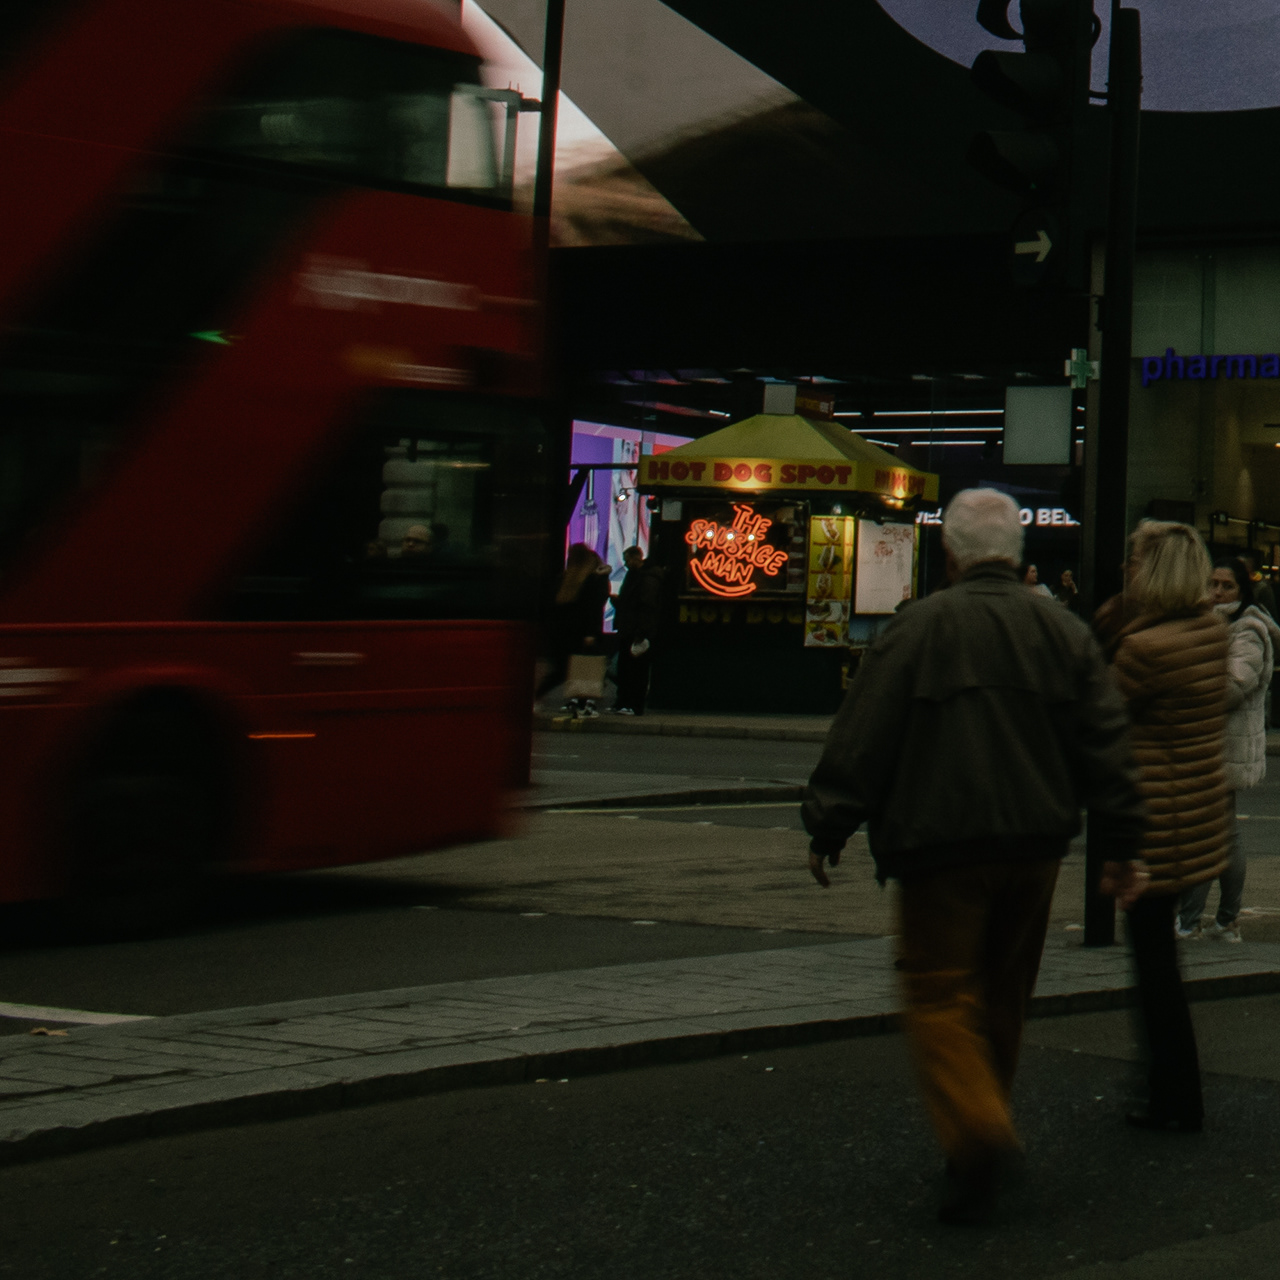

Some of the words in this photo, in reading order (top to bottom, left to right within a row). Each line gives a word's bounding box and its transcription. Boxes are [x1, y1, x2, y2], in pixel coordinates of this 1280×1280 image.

[649, 461, 706, 481] HOT
[714, 462, 772, 483] DOG
[780, 464, 852, 486] SPOT
[732, 504, 773, 542] THE
[684, 519, 789, 577] SAUSAGE
[702, 551, 755, 585] MAN
